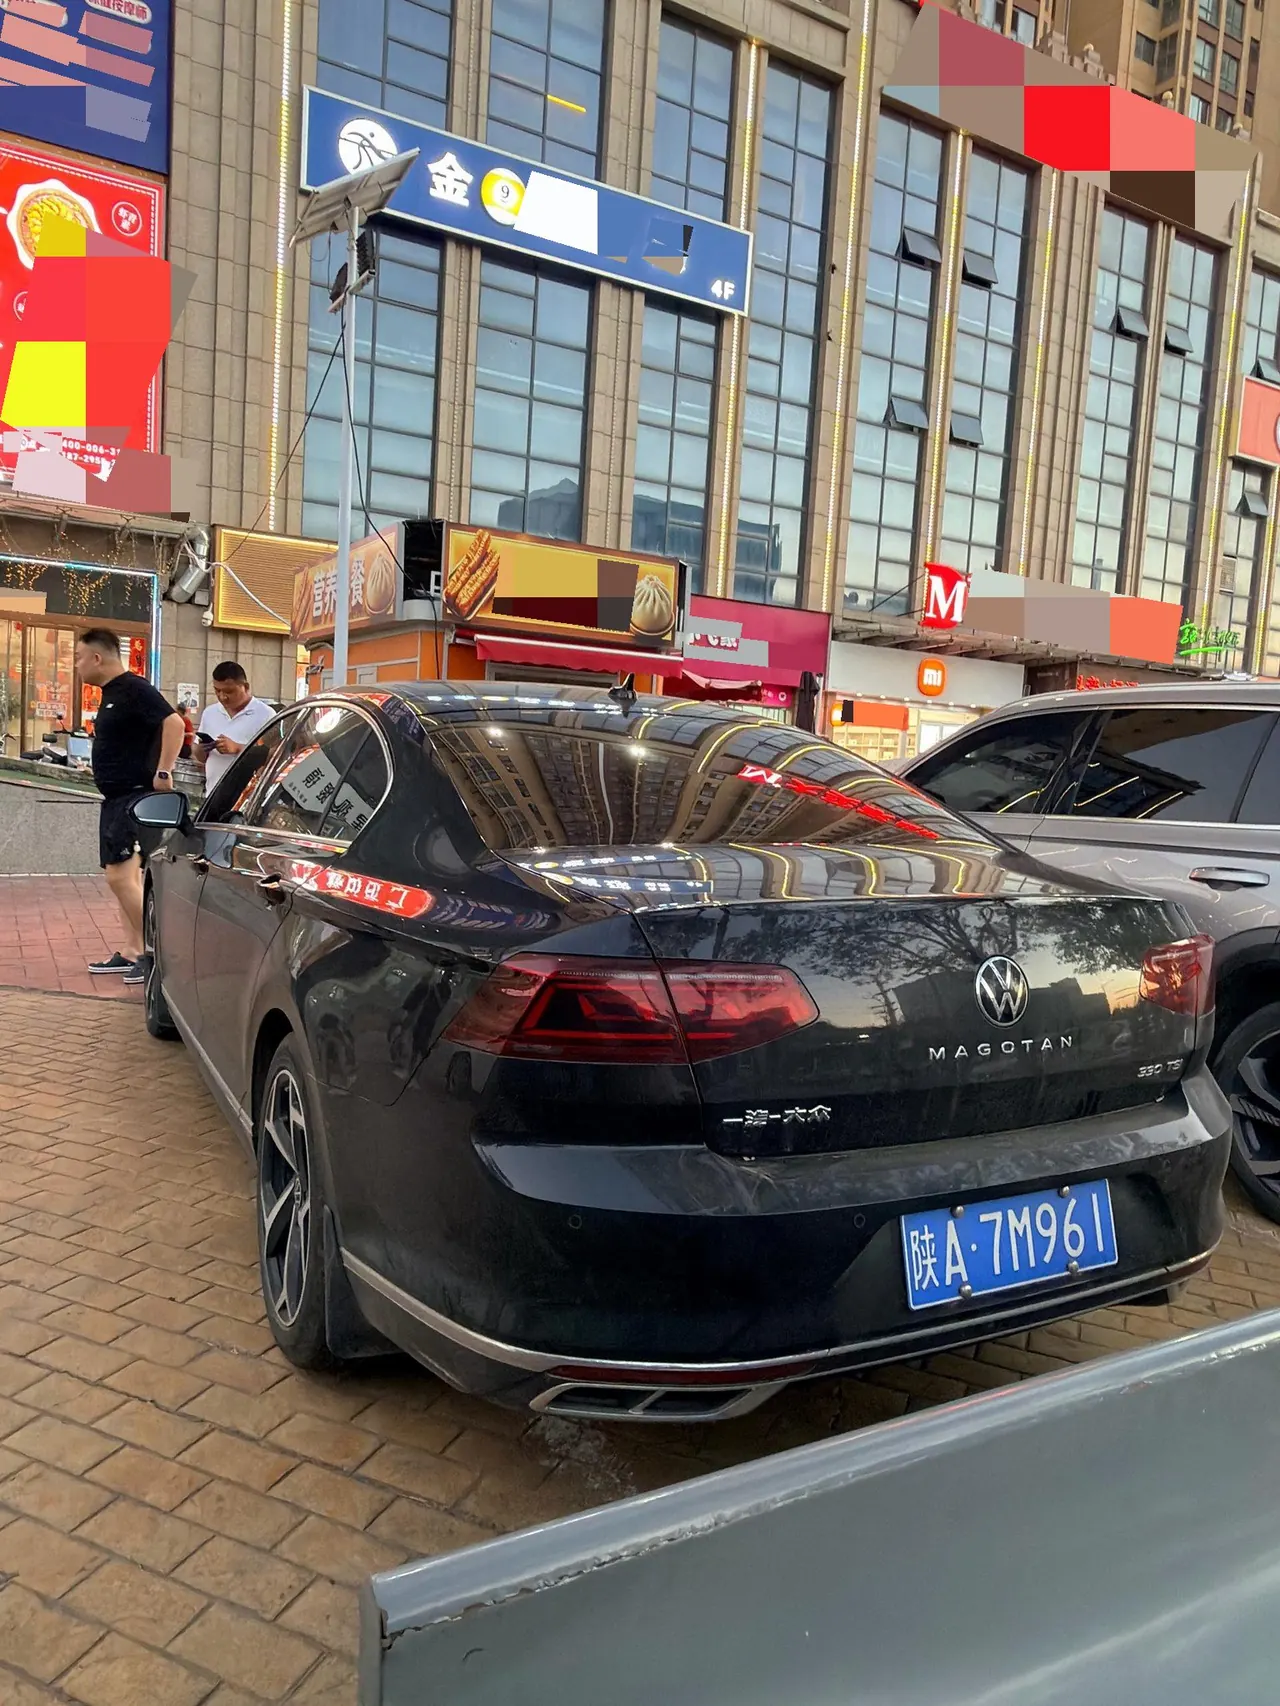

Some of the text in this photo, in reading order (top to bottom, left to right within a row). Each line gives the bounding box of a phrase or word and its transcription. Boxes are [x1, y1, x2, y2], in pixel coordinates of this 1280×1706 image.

[427, 151, 474, 208] 金
[711, 279, 735, 300] 4F
[312, 558, 366, 618] 营养餐
[925, 575, 968, 622] M
[928, 1035, 1073, 1061] MAGOTAN
